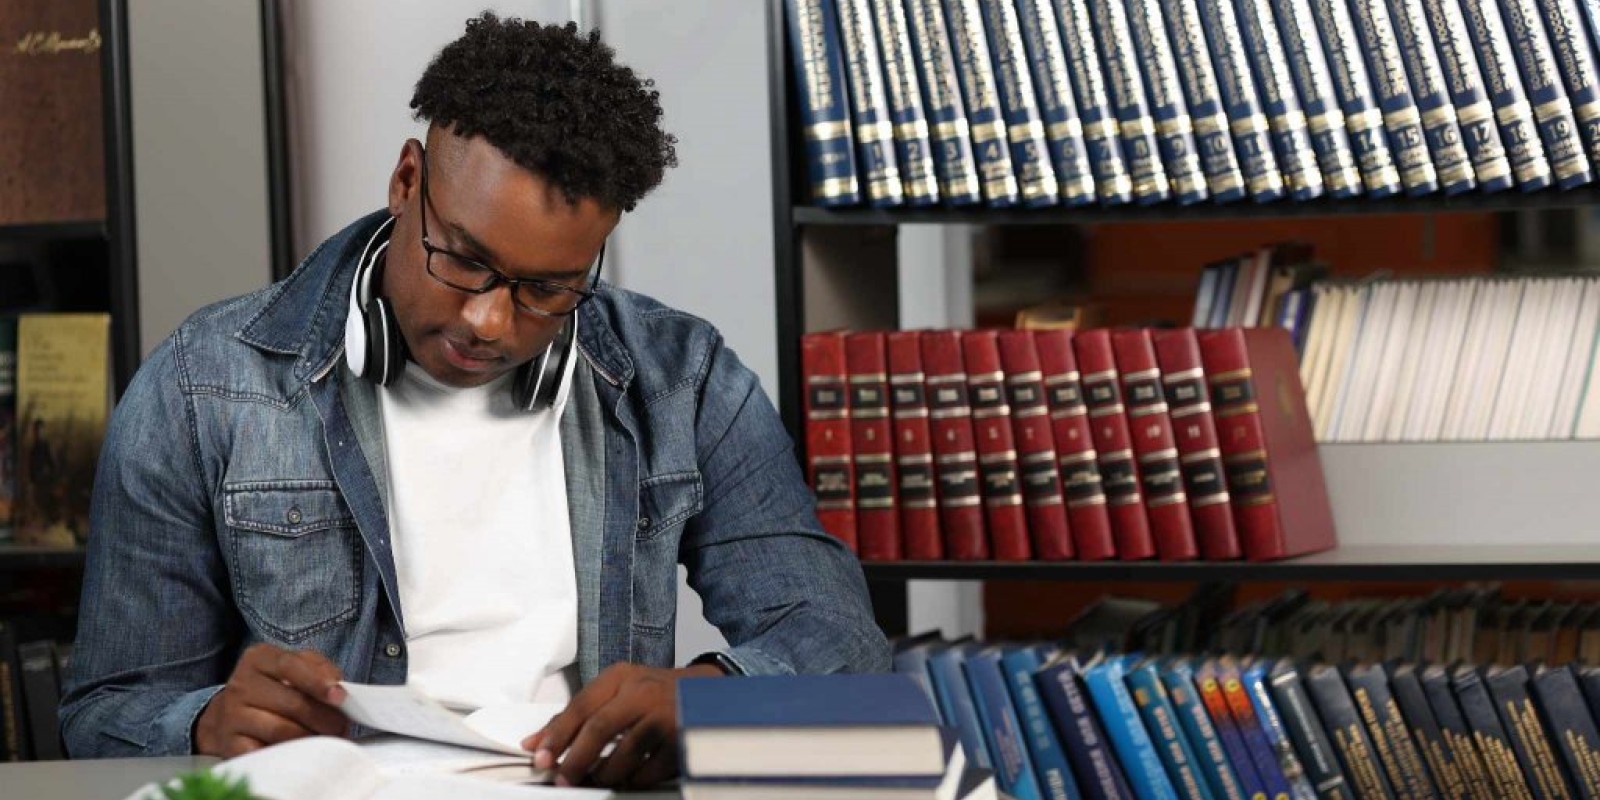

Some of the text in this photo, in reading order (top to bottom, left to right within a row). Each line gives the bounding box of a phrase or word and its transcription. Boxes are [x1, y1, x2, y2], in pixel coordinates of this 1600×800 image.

[1397, 127, 1420, 148] 15
[1435, 126, 1457, 147] 16
[1472, 122, 1490, 141] 17
[1510, 121, 1529, 143] 18
[1549, 120, 1569, 140] 19
[873, 143, 883, 159] 1
[907, 142, 919, 160] 2
[945, 142, 958, 159] 3
[986, 142, 998, 158] 4
[1025, 142, 1039, 161] 5
[1063, 142, 1075, 158] 6
[1135, 139, 1147, 157] 8
[1205, 136, 1228, 154] 10
